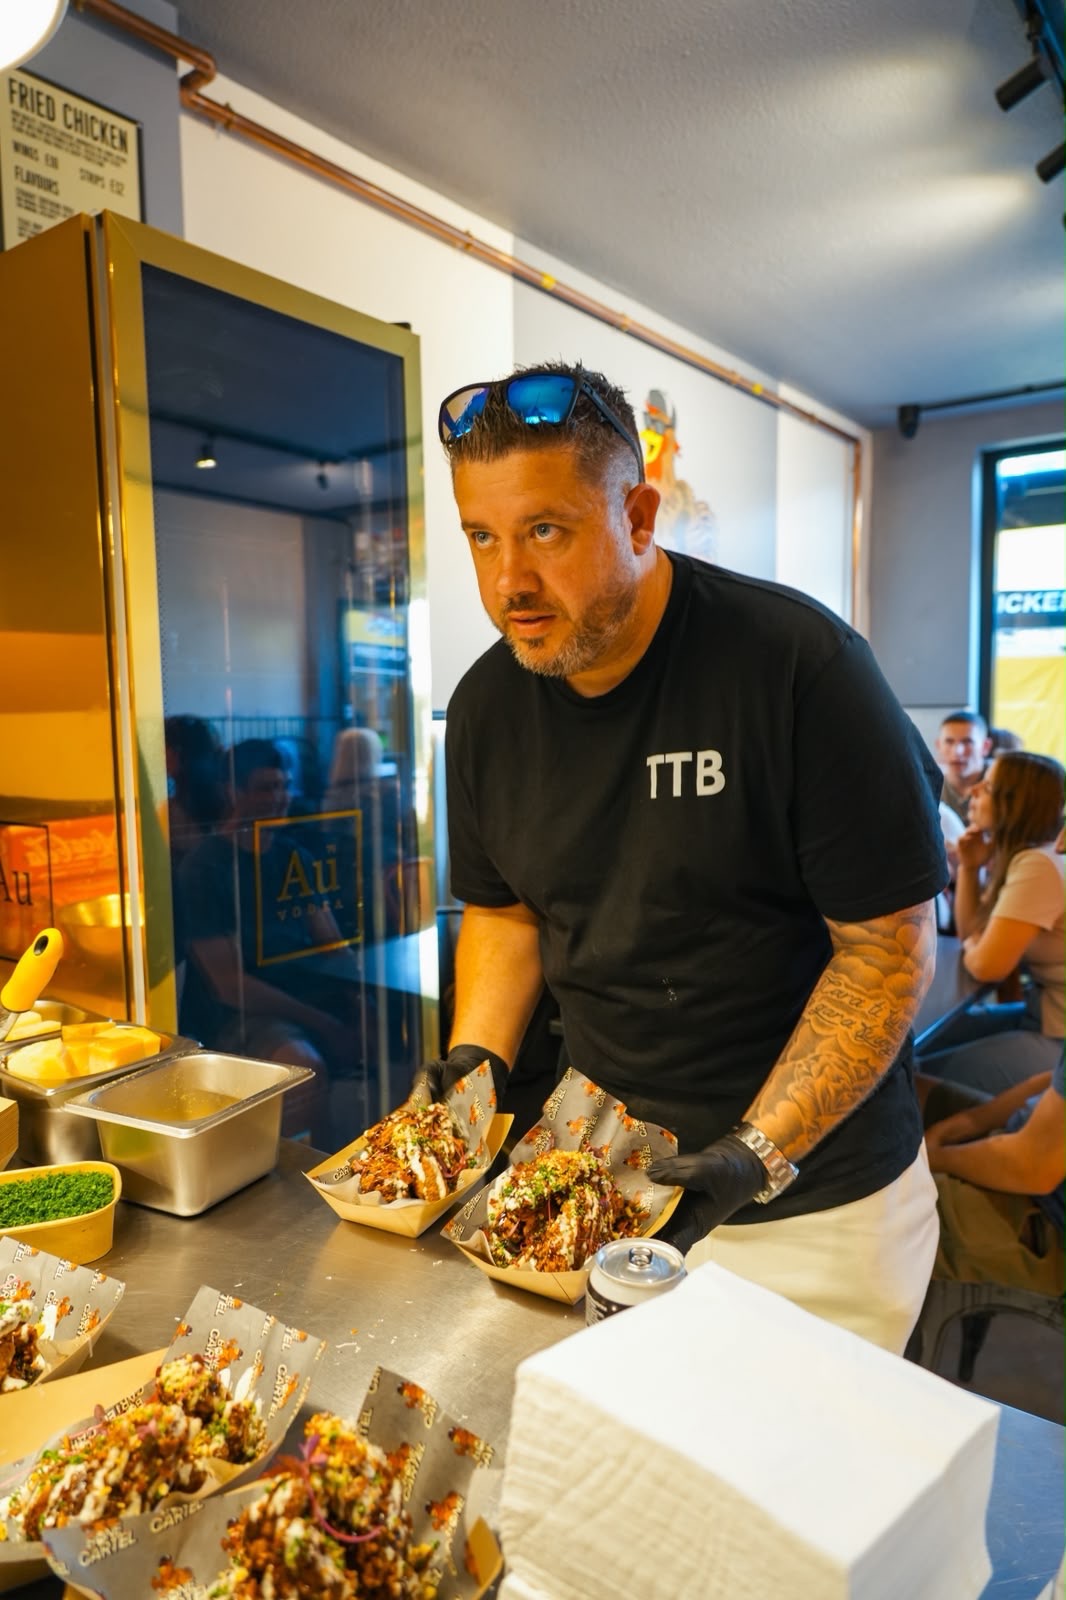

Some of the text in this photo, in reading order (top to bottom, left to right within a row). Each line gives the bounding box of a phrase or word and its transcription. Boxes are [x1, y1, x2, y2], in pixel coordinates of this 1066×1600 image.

[9, 78, 56, 122] FRIED
[63, 103, 128, 154] CHICKEN
[997, 591, 1066, 614] ICKE
[646, 749, 726, 799] TTB
[277, 850, 341, 902] Au
[549, 1089, 566, 1121] CARTEL
[267, 1364, 289, 1421] CARTEL
[150, 1501, 205, 1534] CARTEL
[78, 1529, 139, 1568] CARTEL
